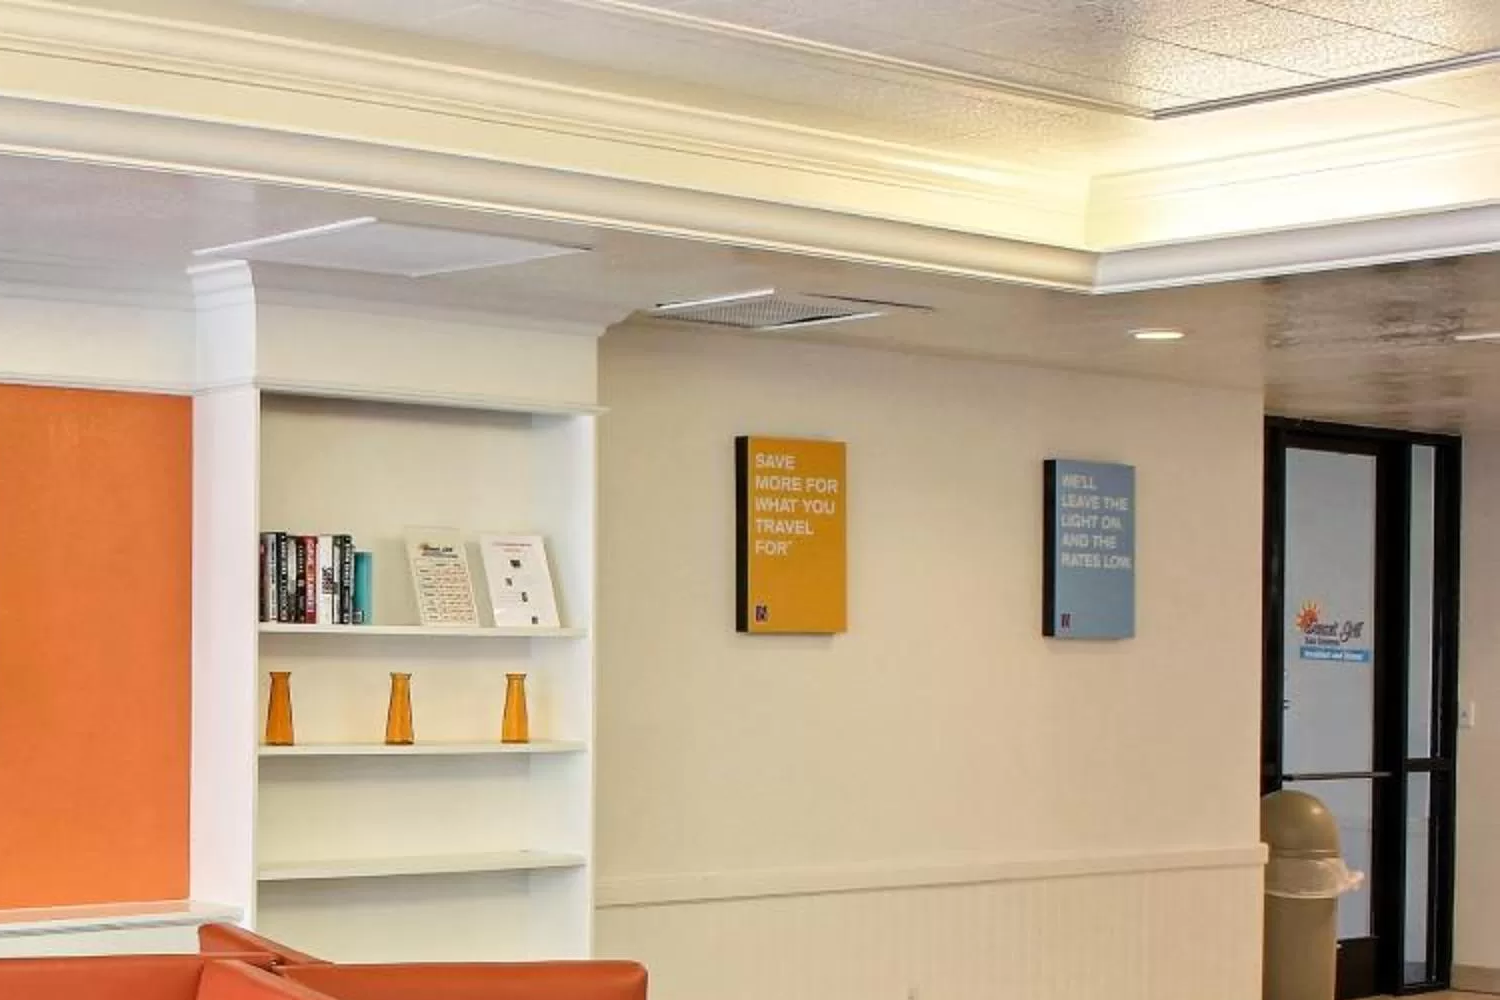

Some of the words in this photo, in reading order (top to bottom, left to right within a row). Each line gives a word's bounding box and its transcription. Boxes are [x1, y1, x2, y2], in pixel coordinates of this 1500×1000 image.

[755, 452, 796, 470] SAVE
[755, 475, 803, 492] MORE
[806, 477, 838, 494] FOR
[755, 496, 799, 513] WHAT
[801, 499, 836, 515] YOU
[1060, 493, 1100, 510] LEAVE
[1103, 496, 1129, 511] THE
[755, 518, 815, 535] TRAVEL
[1060, 513, 1098, 529] LIGHT
[1062, 531, 1090, 548] AND
[1091, 534, 1117, 549] THE
[1061, 551, 1101, 568] RATES
